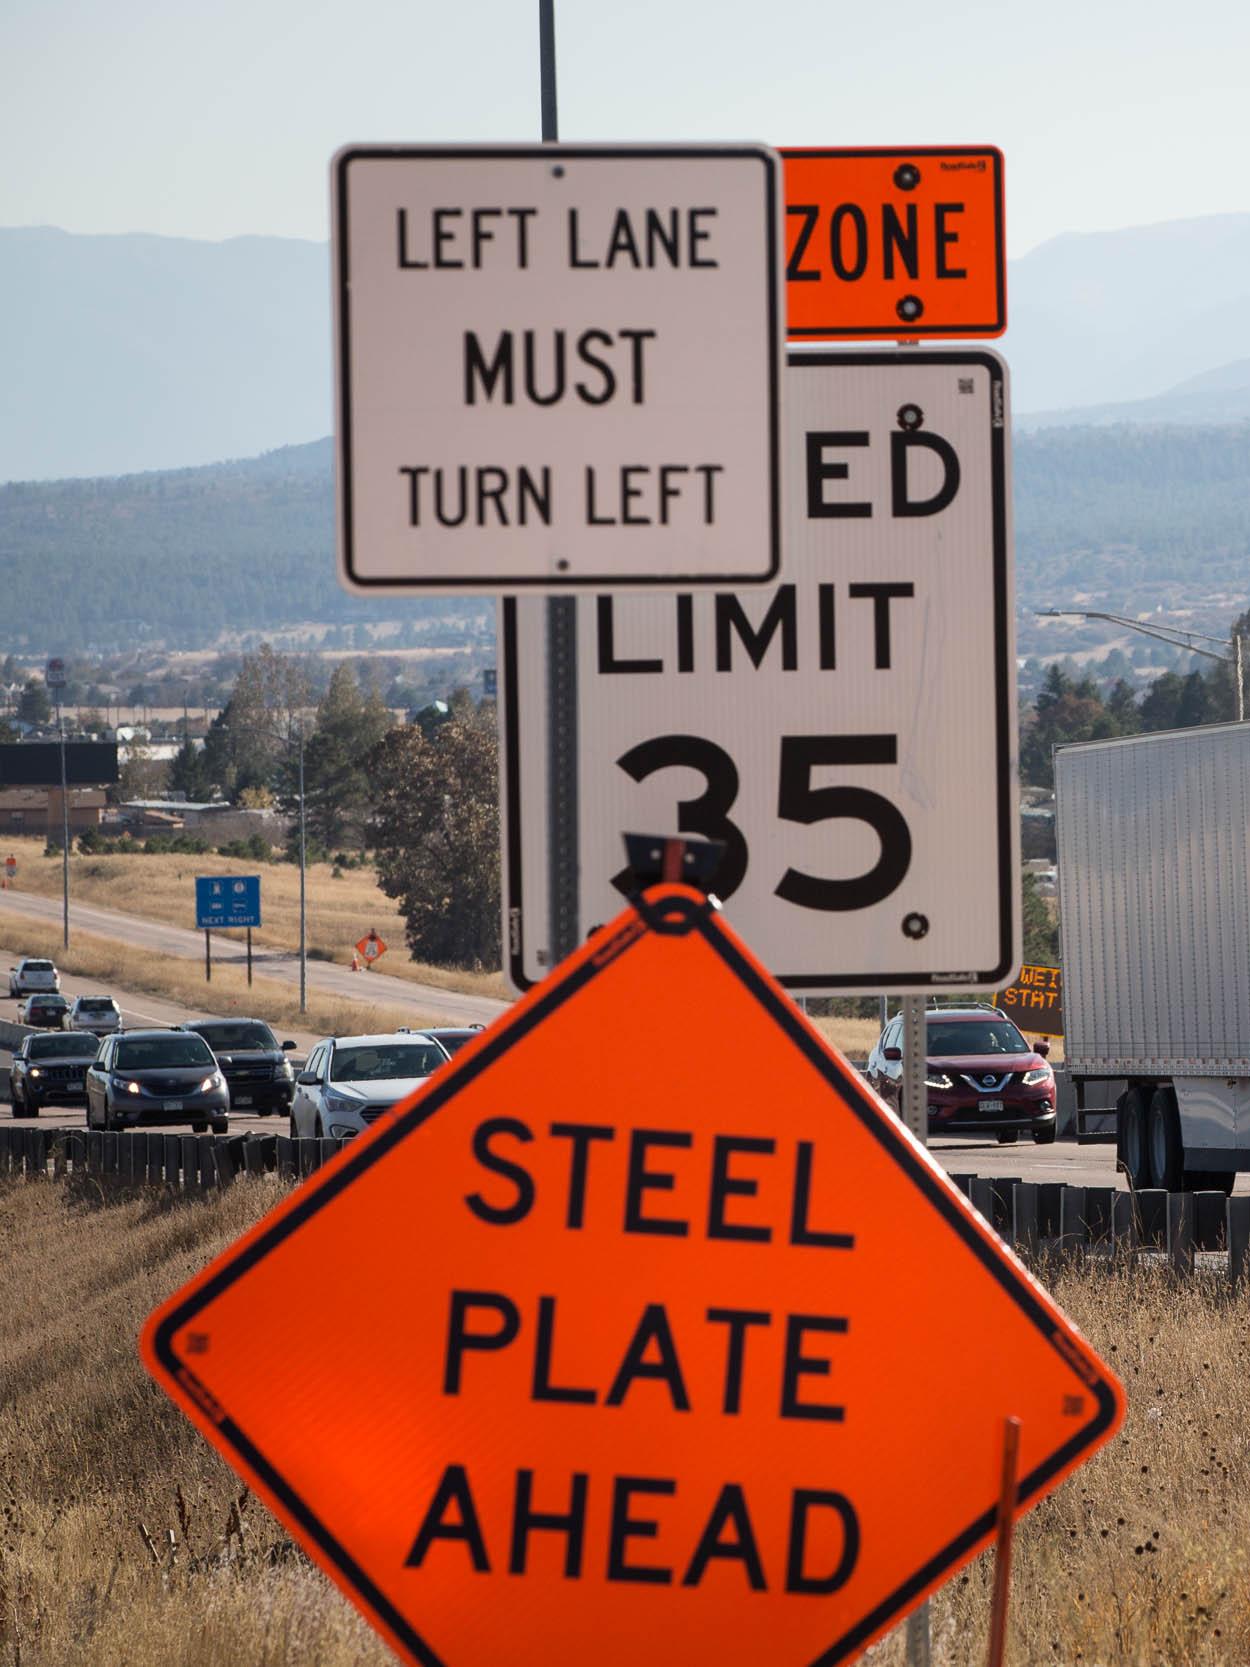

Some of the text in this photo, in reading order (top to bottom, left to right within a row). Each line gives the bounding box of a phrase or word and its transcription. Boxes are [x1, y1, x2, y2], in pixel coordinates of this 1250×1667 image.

[397, 207, 719, 270] LEFT LANE
[787, 202, 968, 282] ZONE
[464, 329, 657, 407] MUST
[399, 464, 723, 528] TURN LEFT
[596, 582, 915, 675] LIMIT
[609, 734, 913, 913] 35
[201, 915, 255, 924] NEXT RIGHT
[1004, 988, 1062, 1009] STAT
[1020, 967, 1062, 988] WEI
[465, 1117, 855, 1249] STEEL
[443, 1290, 849, 1422] PLATE
[404, 1464, 861, 1596] AHEAD
